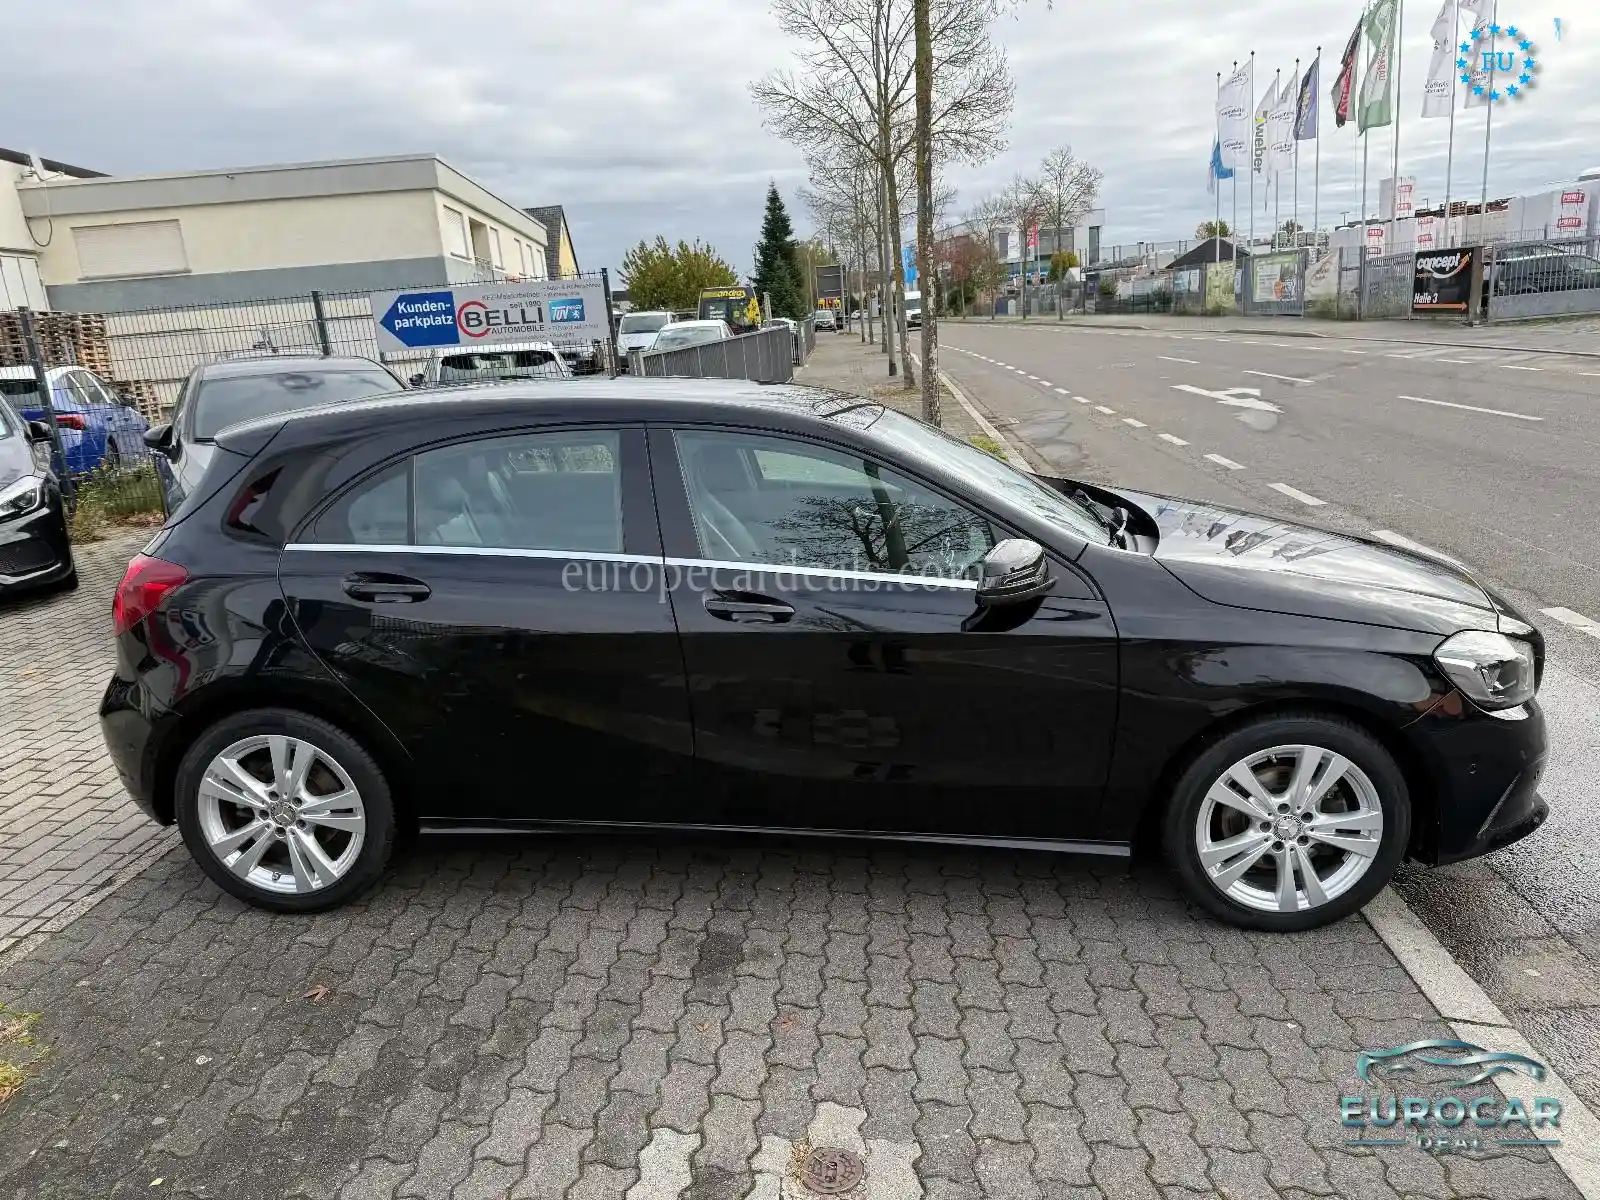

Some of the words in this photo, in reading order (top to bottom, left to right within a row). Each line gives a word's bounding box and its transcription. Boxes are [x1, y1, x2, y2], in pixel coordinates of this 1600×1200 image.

[1253, 123, 1267, 174] weber
[1416, 252, 1461, 272] concept
[1413, 292, 1431, 304] Halle
[1432, 292, 1439, 303] 3
[397, 300, 451, 314] Kunden-
[394, 314, 454, 331] parkplatz
[464, 307, 545, 328] BELLI
[491, 325, 545, 335] AUTOMOBILE
